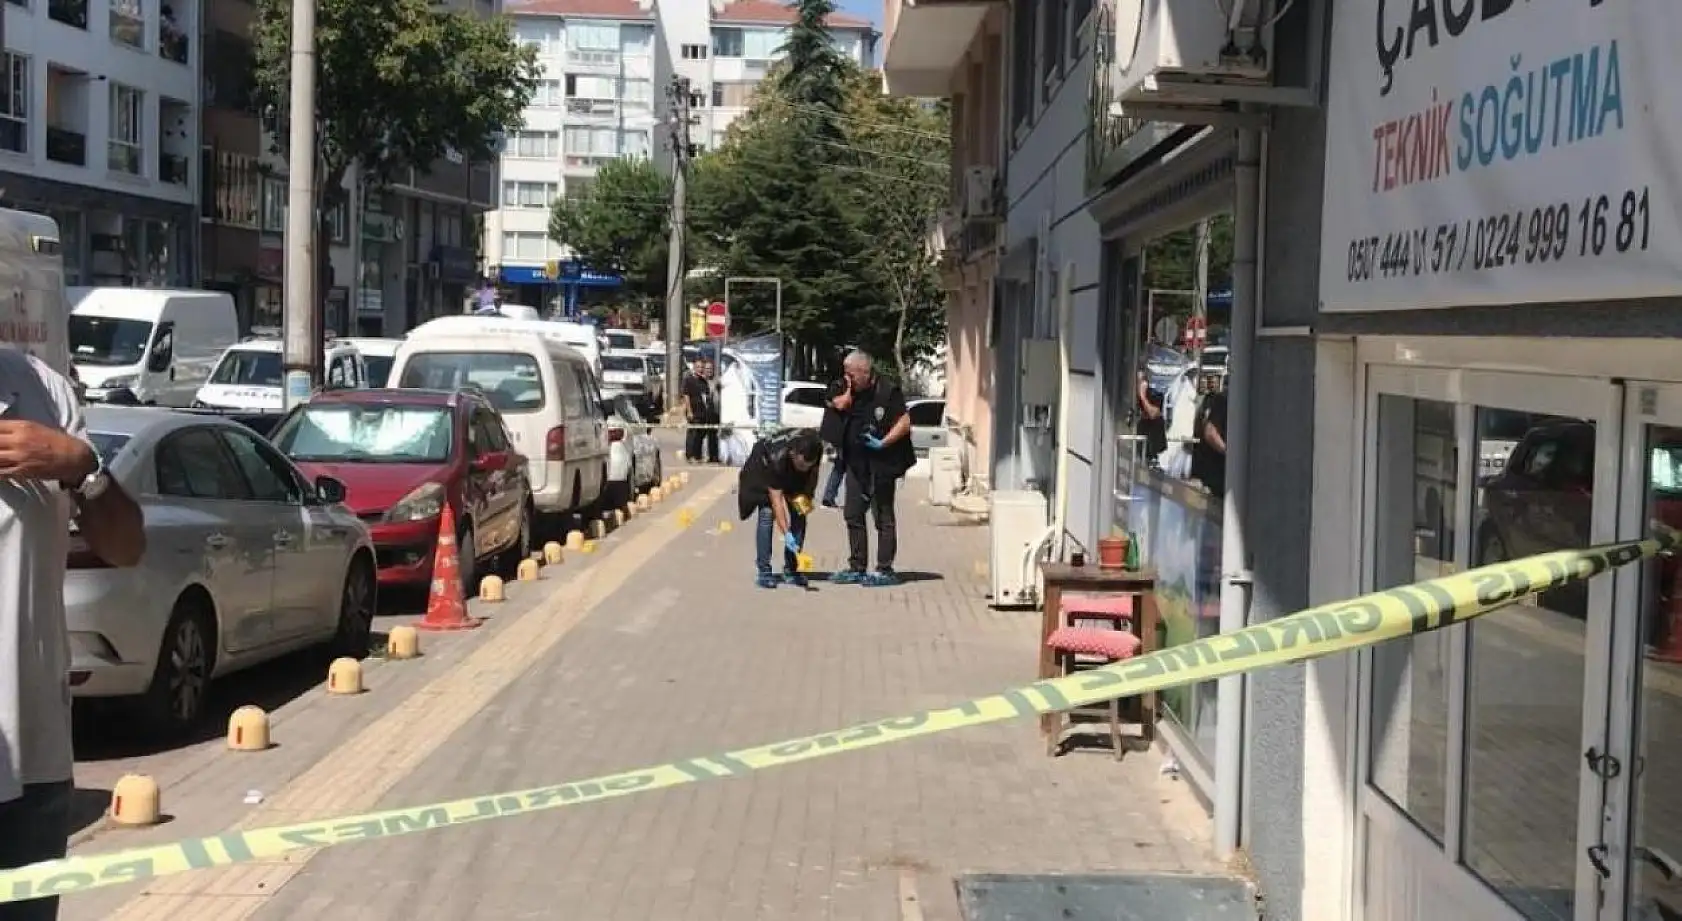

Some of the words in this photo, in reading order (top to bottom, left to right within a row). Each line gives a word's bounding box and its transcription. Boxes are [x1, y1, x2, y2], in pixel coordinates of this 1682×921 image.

[1372, 86, 1452, 193] TEKNİK
[1456, 39, 1624, 172] SOĞUTMA
[1380, 232, 1409, 278] 444
[1431, 223, 1457, 272] 51
[1474, 210, 1524, 271] 0224
[1525, 203, 1570, 264] 999
[1579, 195, 1609, 257] 16
[1616, 185, 1650, 251] 81
